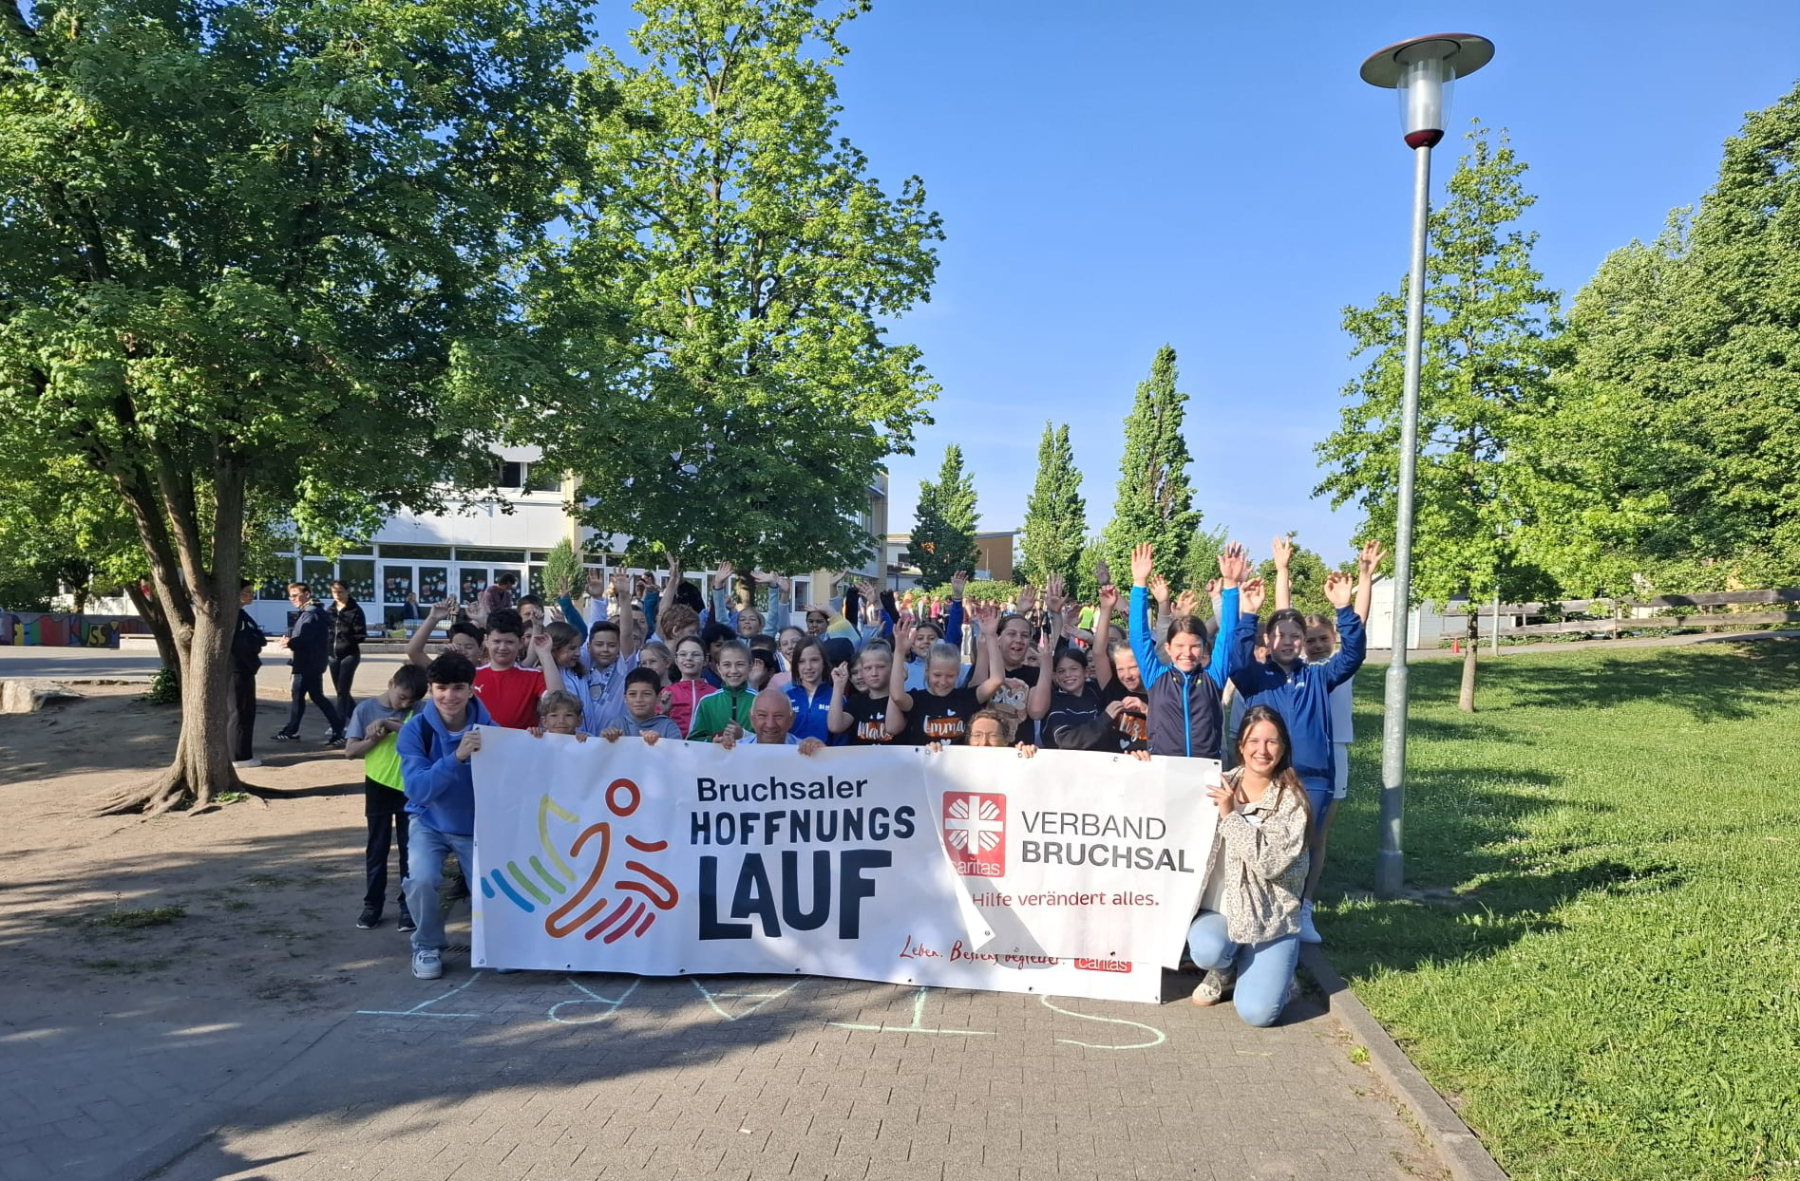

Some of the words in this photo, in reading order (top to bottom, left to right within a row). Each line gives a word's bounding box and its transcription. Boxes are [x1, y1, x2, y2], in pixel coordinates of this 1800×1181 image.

[696, 775, 868, 802] Bruchsaler
[690, 805, 916, 846] HOFFNUNGS
[1021, 810, 1167, 840] VERBAND
[1021, 840, 1195, 874] BRUCHSAL
[698, 848, 893, 941] LAUF
[972, 891, 1012, 907] Hilfe
[1018, 890, 1106, 906] verändert
[1112, 890, 1160, 906] alles.
[899, 934, 943, 959] Leben.
